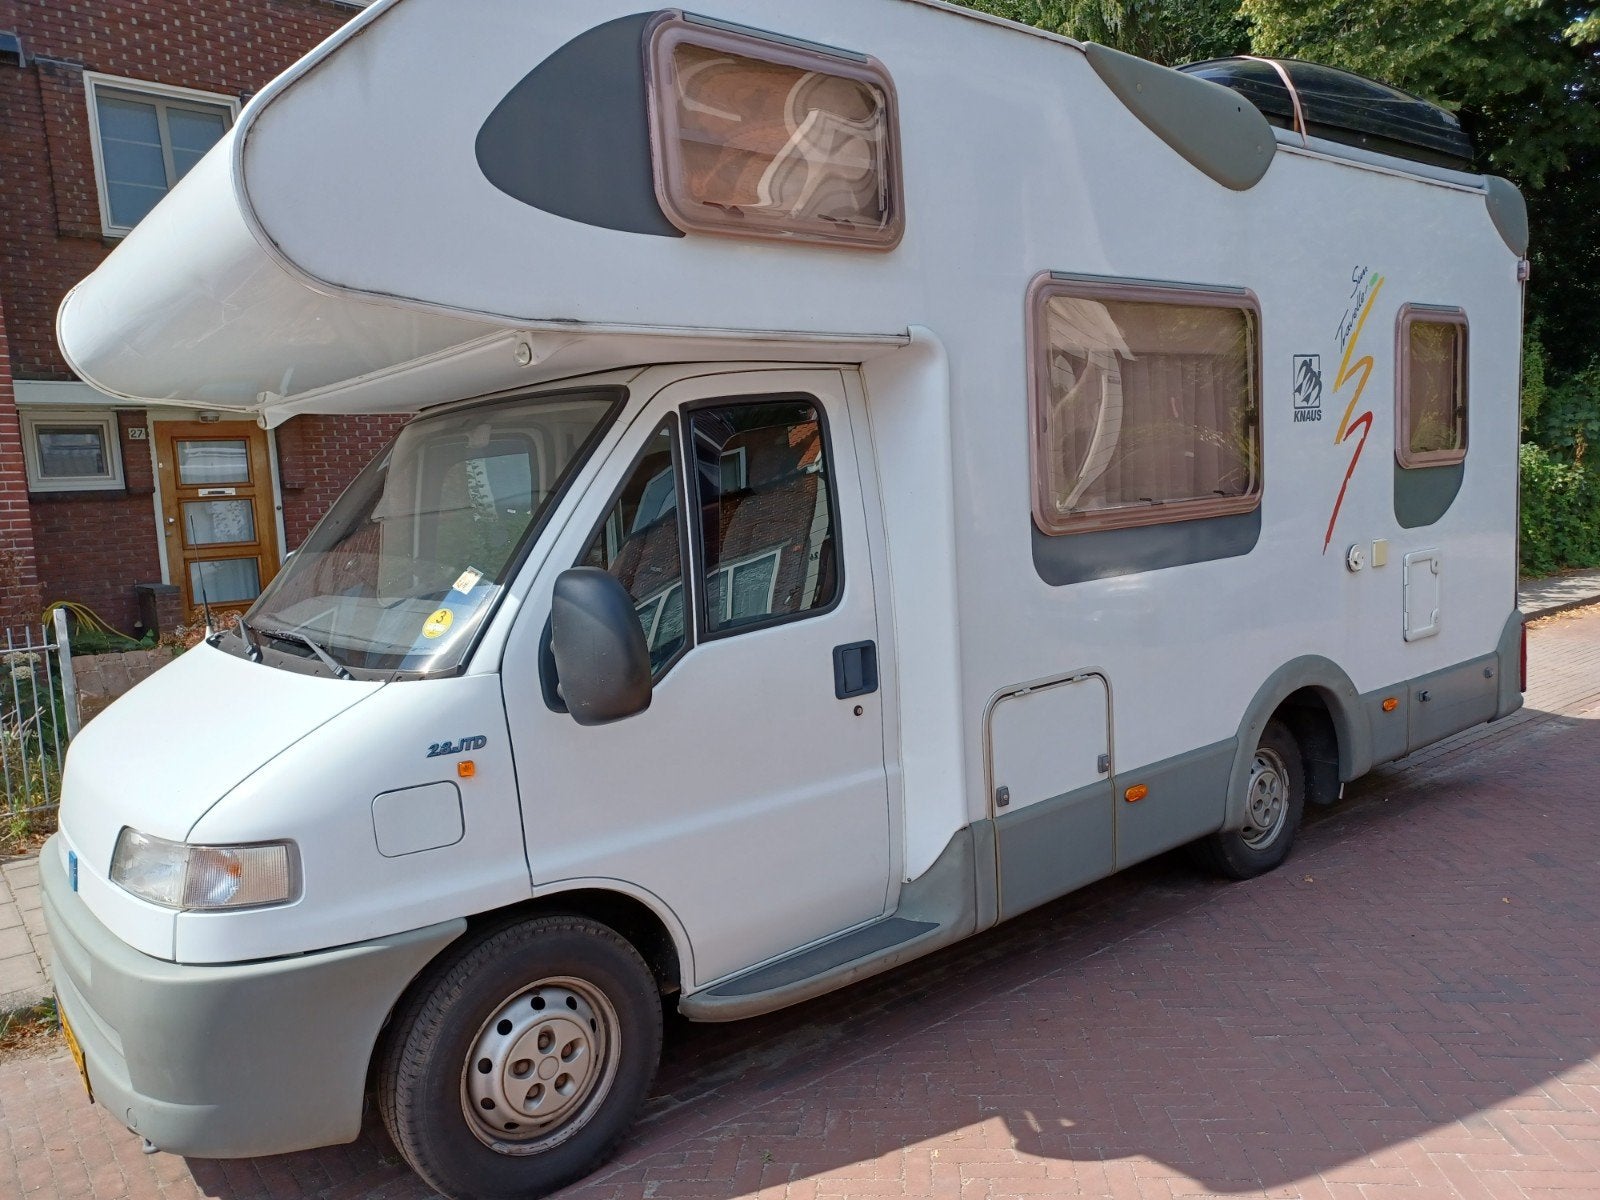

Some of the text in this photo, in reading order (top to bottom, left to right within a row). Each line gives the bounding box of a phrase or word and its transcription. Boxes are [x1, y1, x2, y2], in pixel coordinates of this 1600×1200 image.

[1293, 409, 1322, 422] KNAUS
[130, 429, 143, 438] 27
[436, 610, 447, 624] 3
